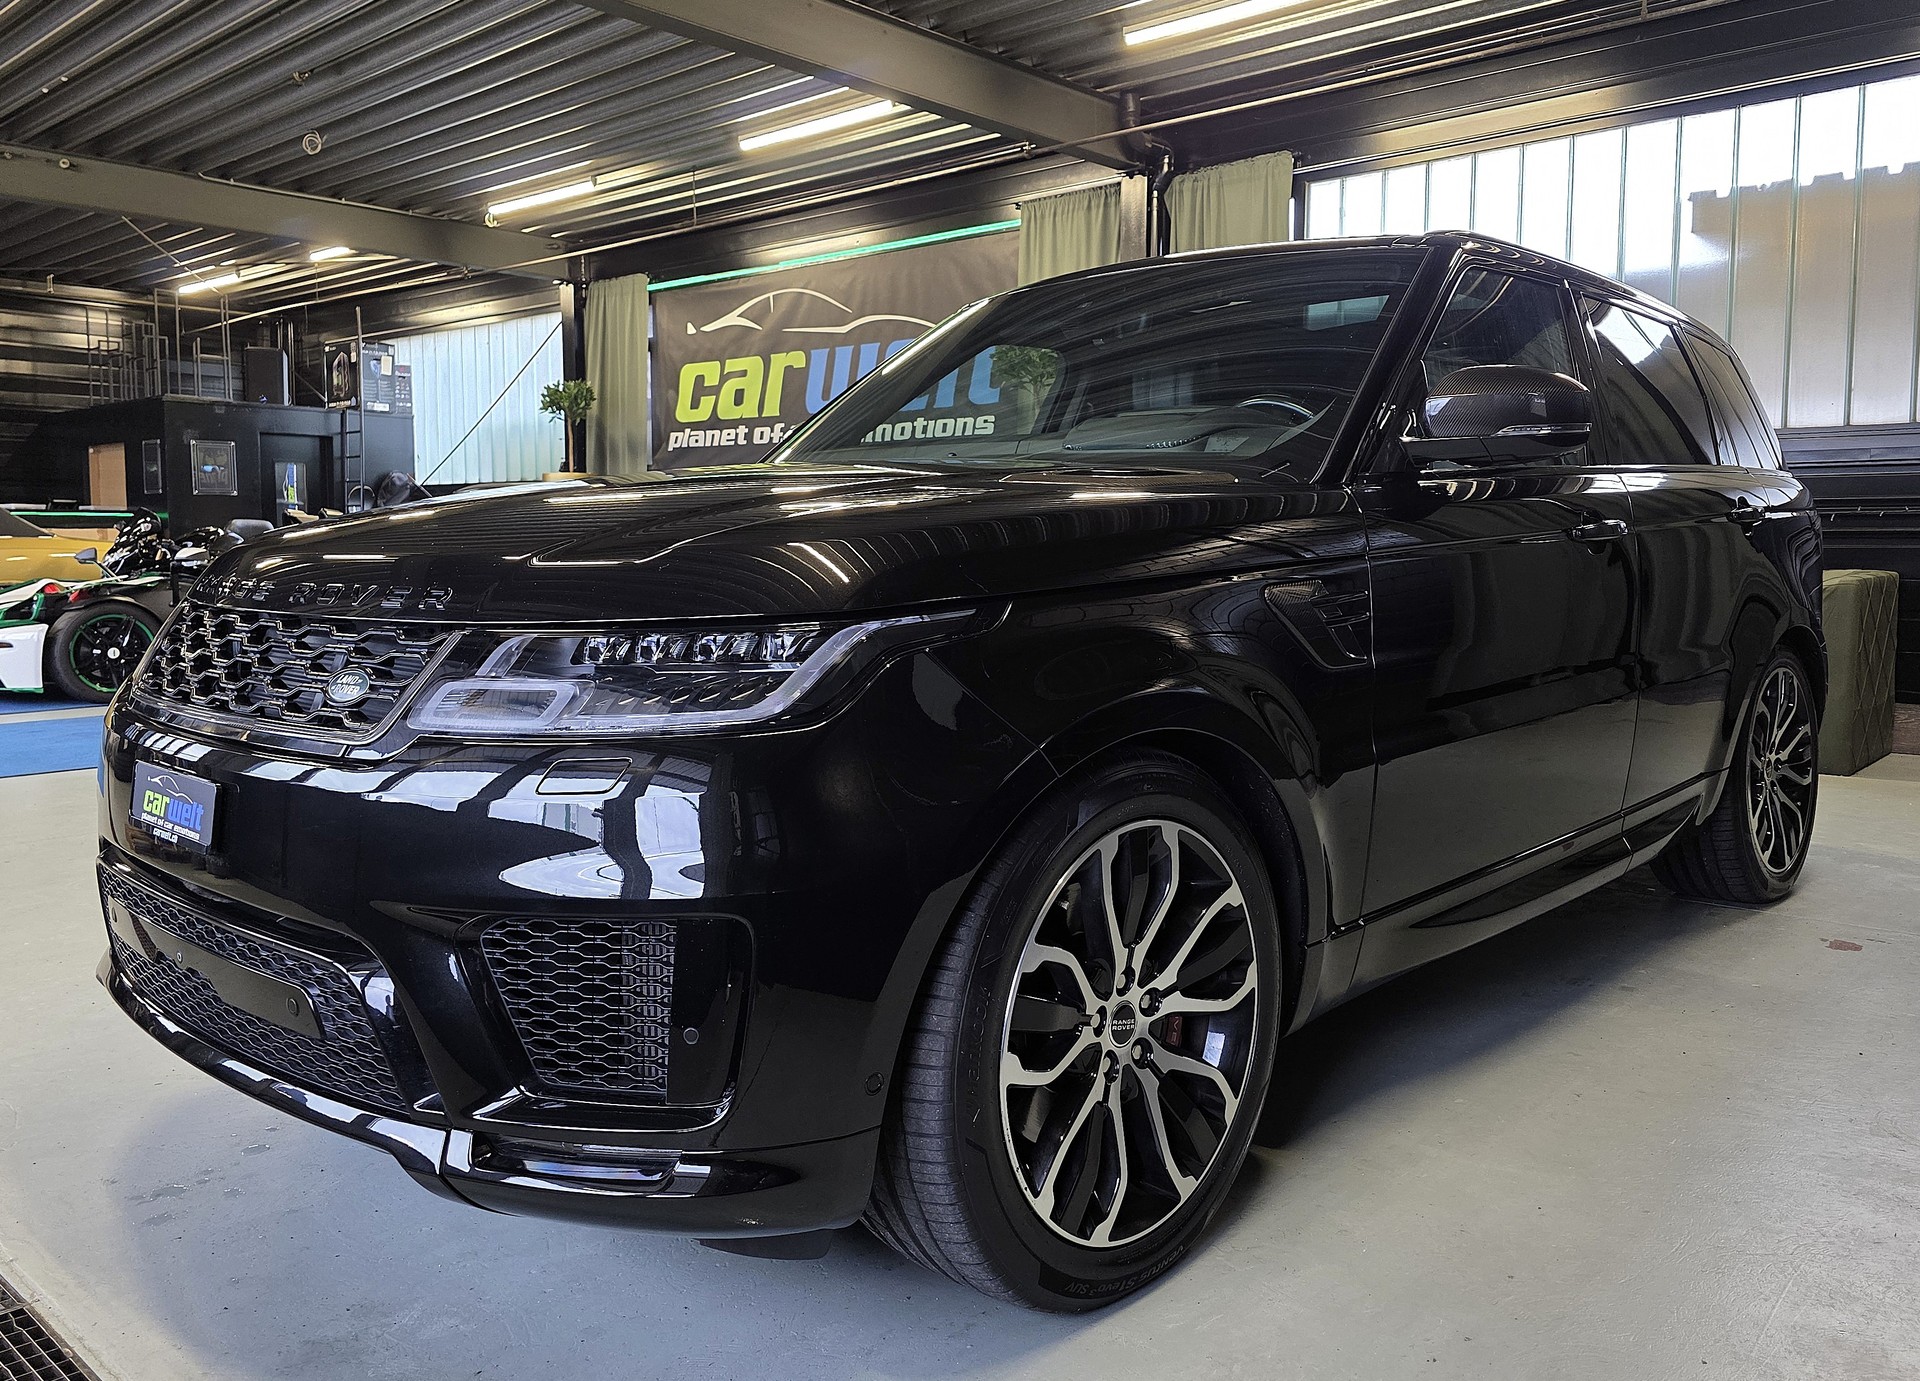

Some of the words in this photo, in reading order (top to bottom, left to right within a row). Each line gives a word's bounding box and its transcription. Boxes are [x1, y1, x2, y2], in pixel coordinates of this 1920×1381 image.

[667, 424, 749, 452] planet
[752, 422, 786, 445] of
[861, 415, 996, 444] motions
[290, 582, 454, 611] ROVER
[337, 674, 359, 684] LAND
[333, 684, 360, 696] ROVER
[143, 789, 204, 832] carwelt
[1064, 1281, 1090, 1295] SUV
